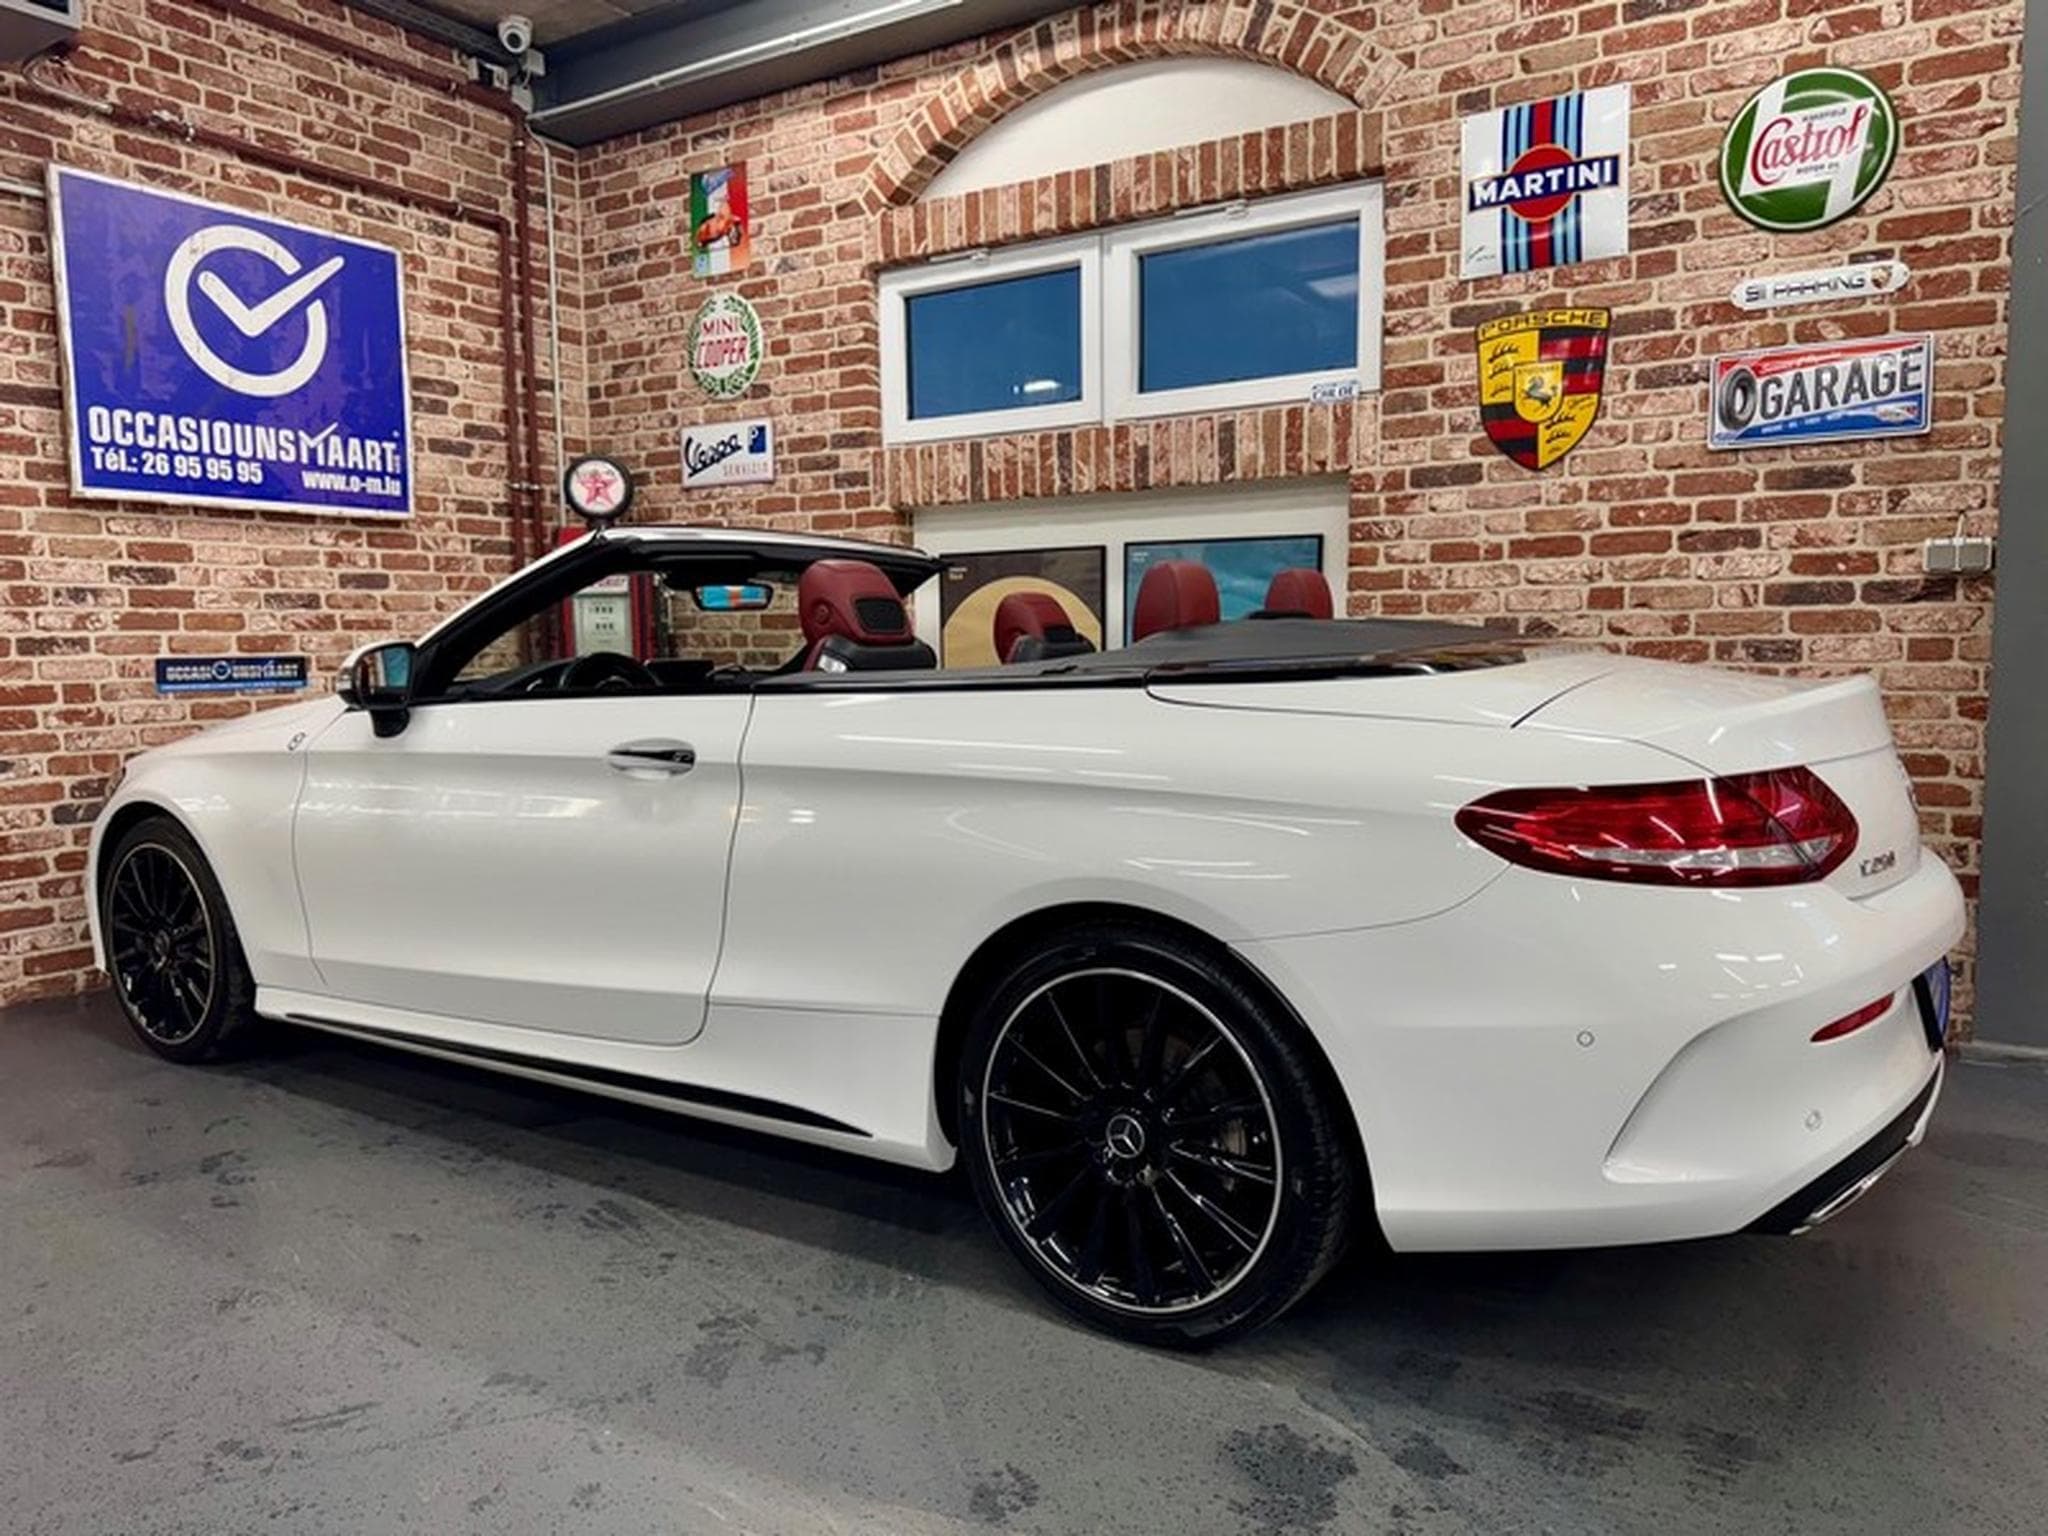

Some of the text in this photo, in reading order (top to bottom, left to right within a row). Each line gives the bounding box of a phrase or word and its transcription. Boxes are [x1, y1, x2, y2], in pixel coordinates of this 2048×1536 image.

[1750, 104, 1869, 187] Castrol
[1473, 159, 1613, 207] MARTINI
[702, 316, 739, 336] MINI
[1481, 311, 1604, 339] PORSCHE
[696, 336, 748, 369] COOPER
[1759, 345, 1924, 420] GARAGE
[90, 446, 264, 485] Tél.: 26 95 95 95
[684, 433, 743, 478] Vespa
[301, 470, 402, 497] www.o-m.lu
